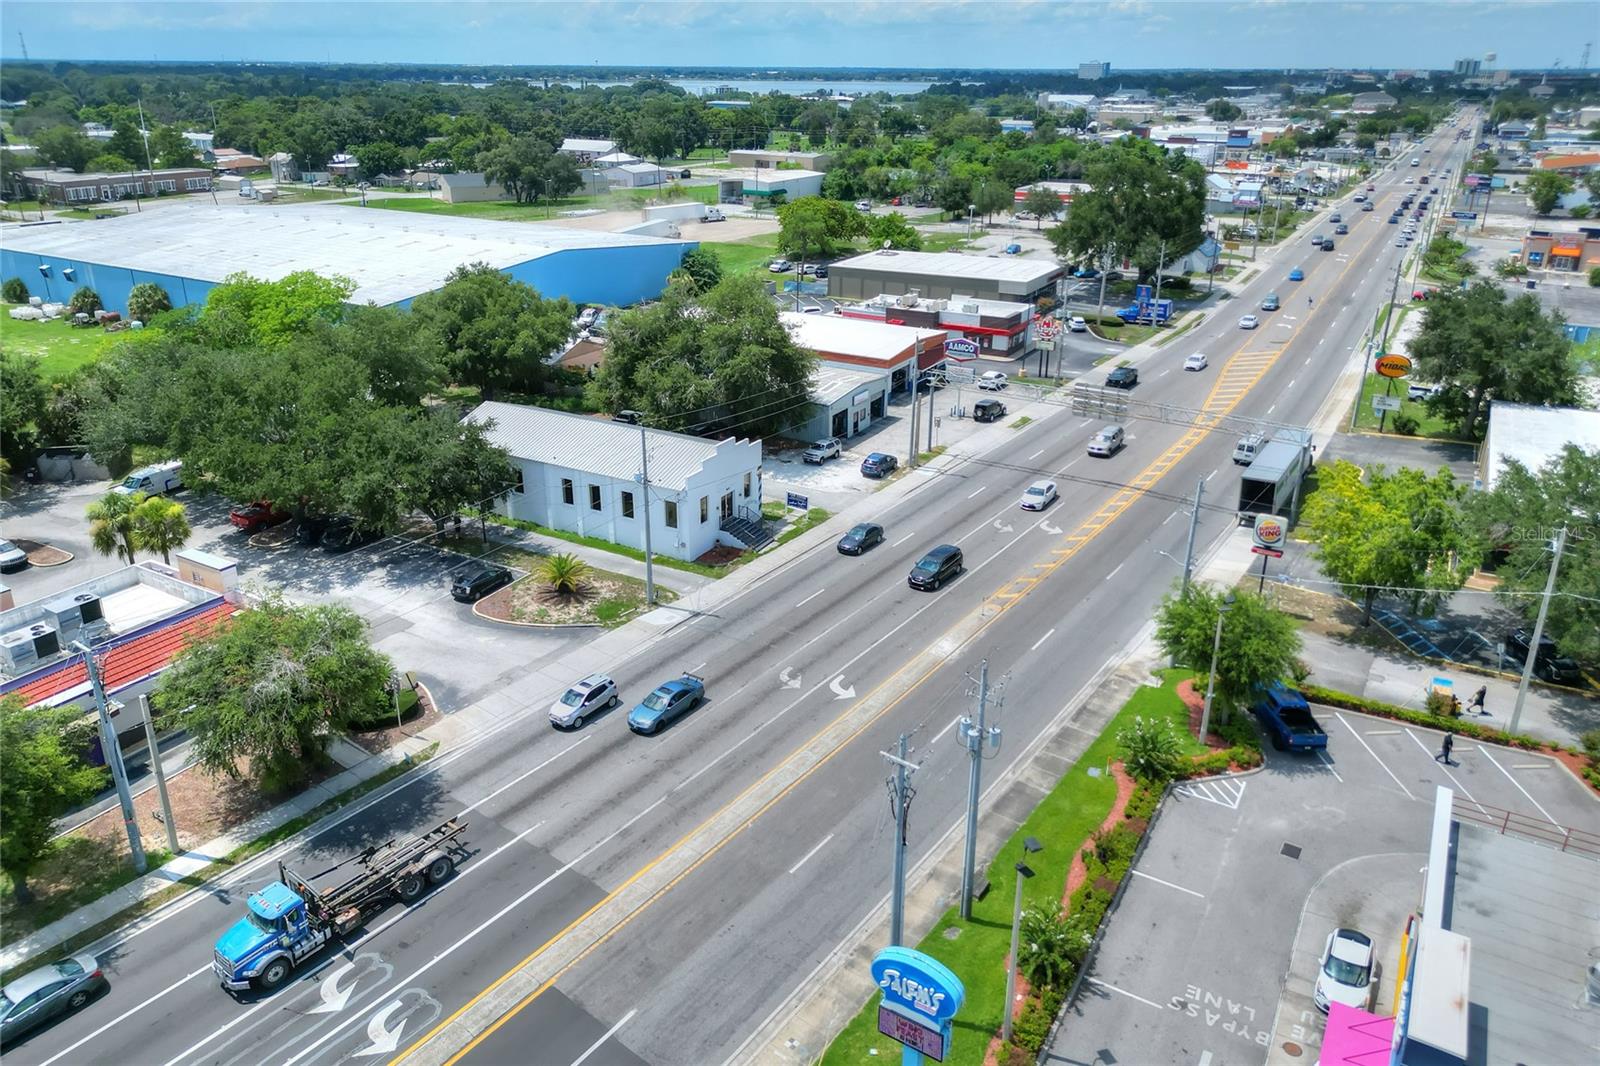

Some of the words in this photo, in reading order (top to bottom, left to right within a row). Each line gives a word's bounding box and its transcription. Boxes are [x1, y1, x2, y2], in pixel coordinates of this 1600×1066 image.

[948, 342, 975, 353] AAMCO
[1259, 529, 1281, 537] KING
[1184, 984, 1256, 1022] LANE
[1167, 996, 1271, 1046] BYPASS
